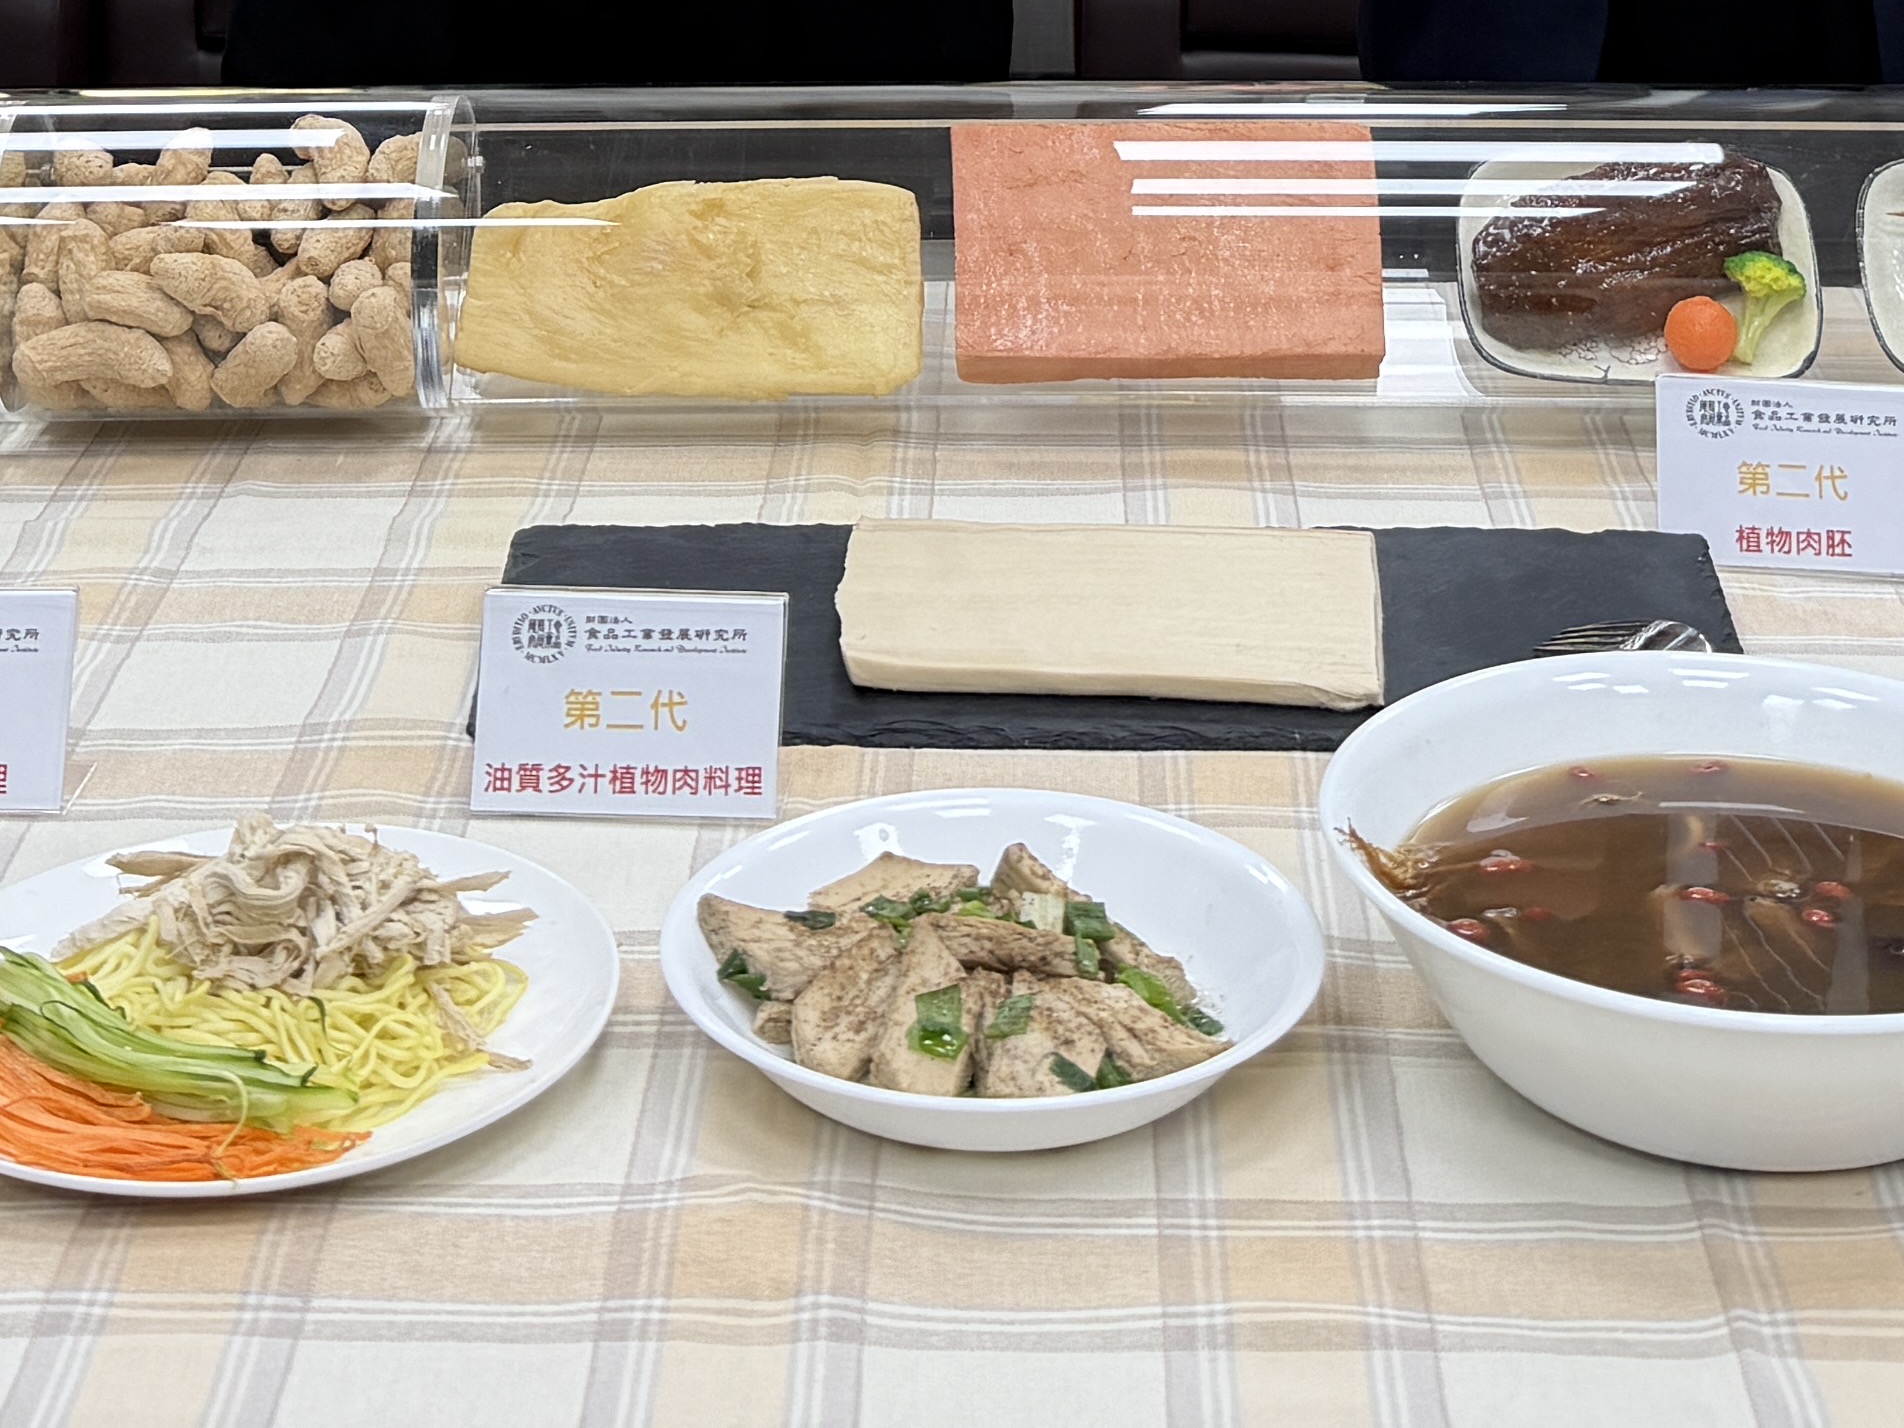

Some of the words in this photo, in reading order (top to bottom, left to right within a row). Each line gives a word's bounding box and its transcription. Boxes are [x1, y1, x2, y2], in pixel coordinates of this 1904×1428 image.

[1736, 460, 1849, 501] 第二代
[1735, 524, 1852, 557] 植物肉胚
[563, 689, 688, 732] 第二代
[484, 762, 763, 796] 油質多汁植物肉料理
